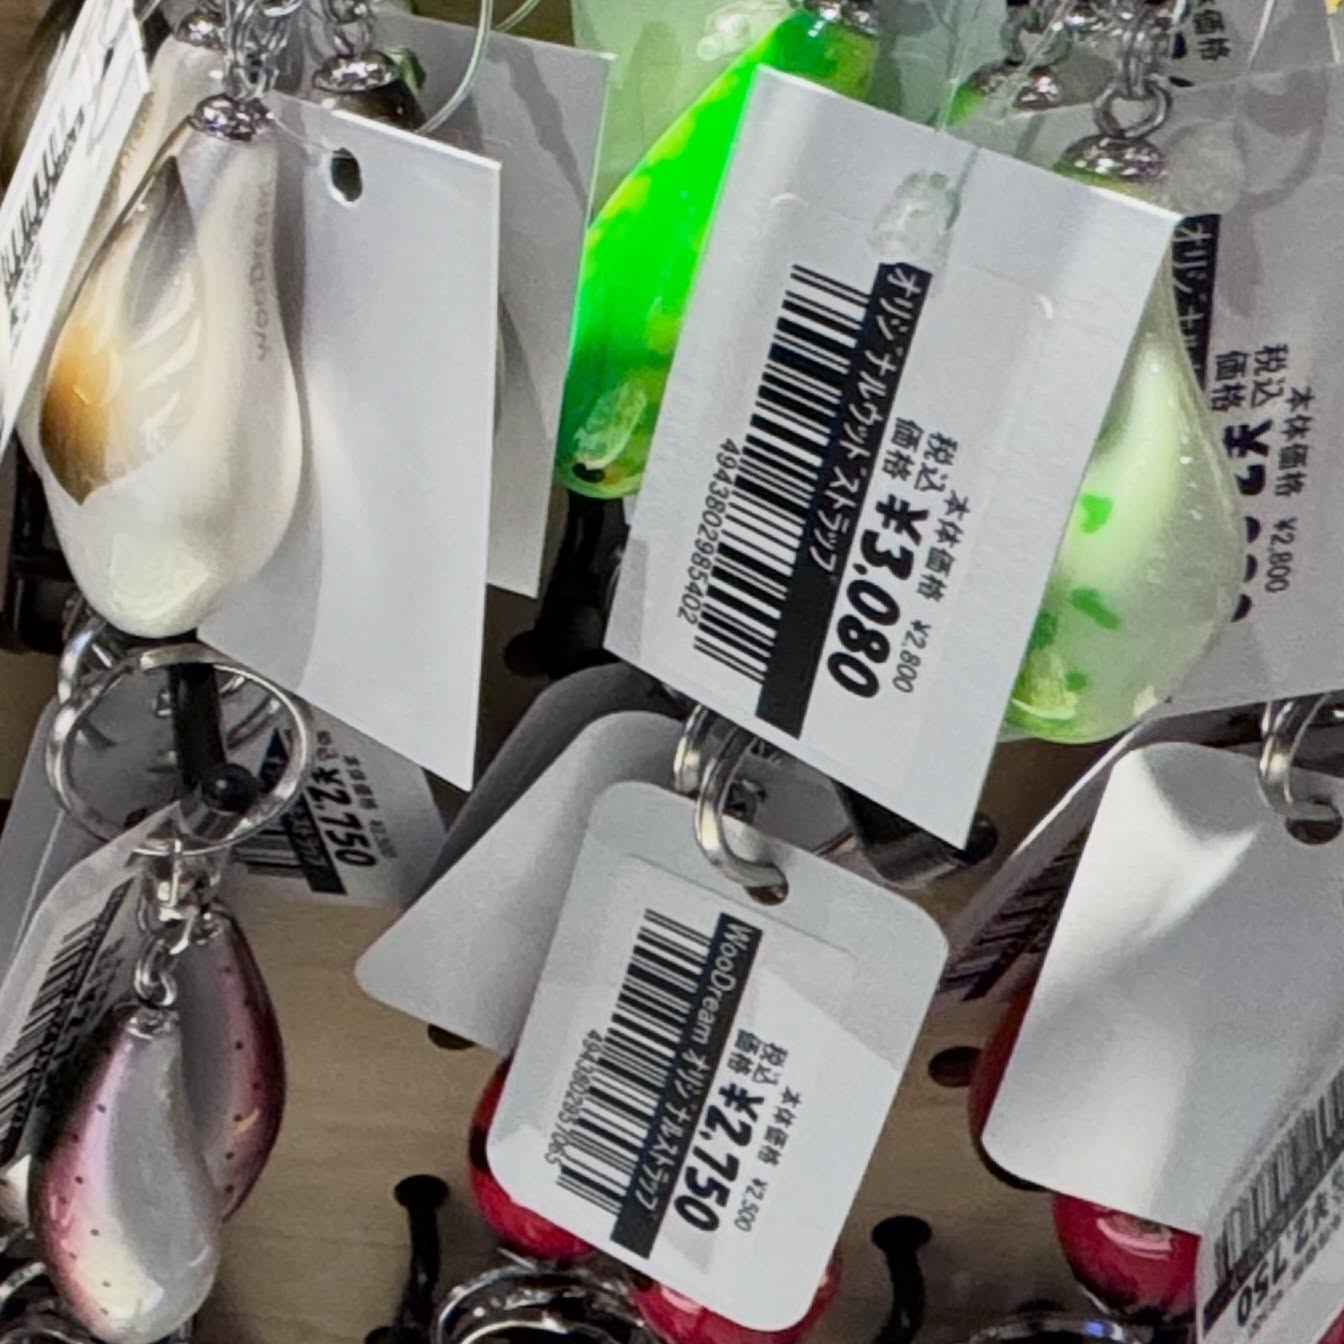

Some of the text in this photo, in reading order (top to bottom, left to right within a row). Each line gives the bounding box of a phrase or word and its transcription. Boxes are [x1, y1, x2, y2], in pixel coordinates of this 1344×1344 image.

[1210, 349, 1251, 413] 価格
[1250, 342, 1289, 411] 税込
[881, 416, 925, 482] 価格
[915, 431, 959, 494] 税込
[1274, 386, 1316, 498] 本体価格
[676, 436, 740, 626] 4943802985402
[826, 493, 929, 699] ¥3,080
[891, 489, 972, 694] 本体価格 ¥2,800
[635, 921, 756, 1211] WooDream オリジナルストラップ
[728, 1029, 758, 1076] 価格
[753, 1042, 791, 1086] 税込
[673, 1083, 767, 1234] ¥2,750
[742, 1090, 804, 1233] 本体価格 ¥2,500
